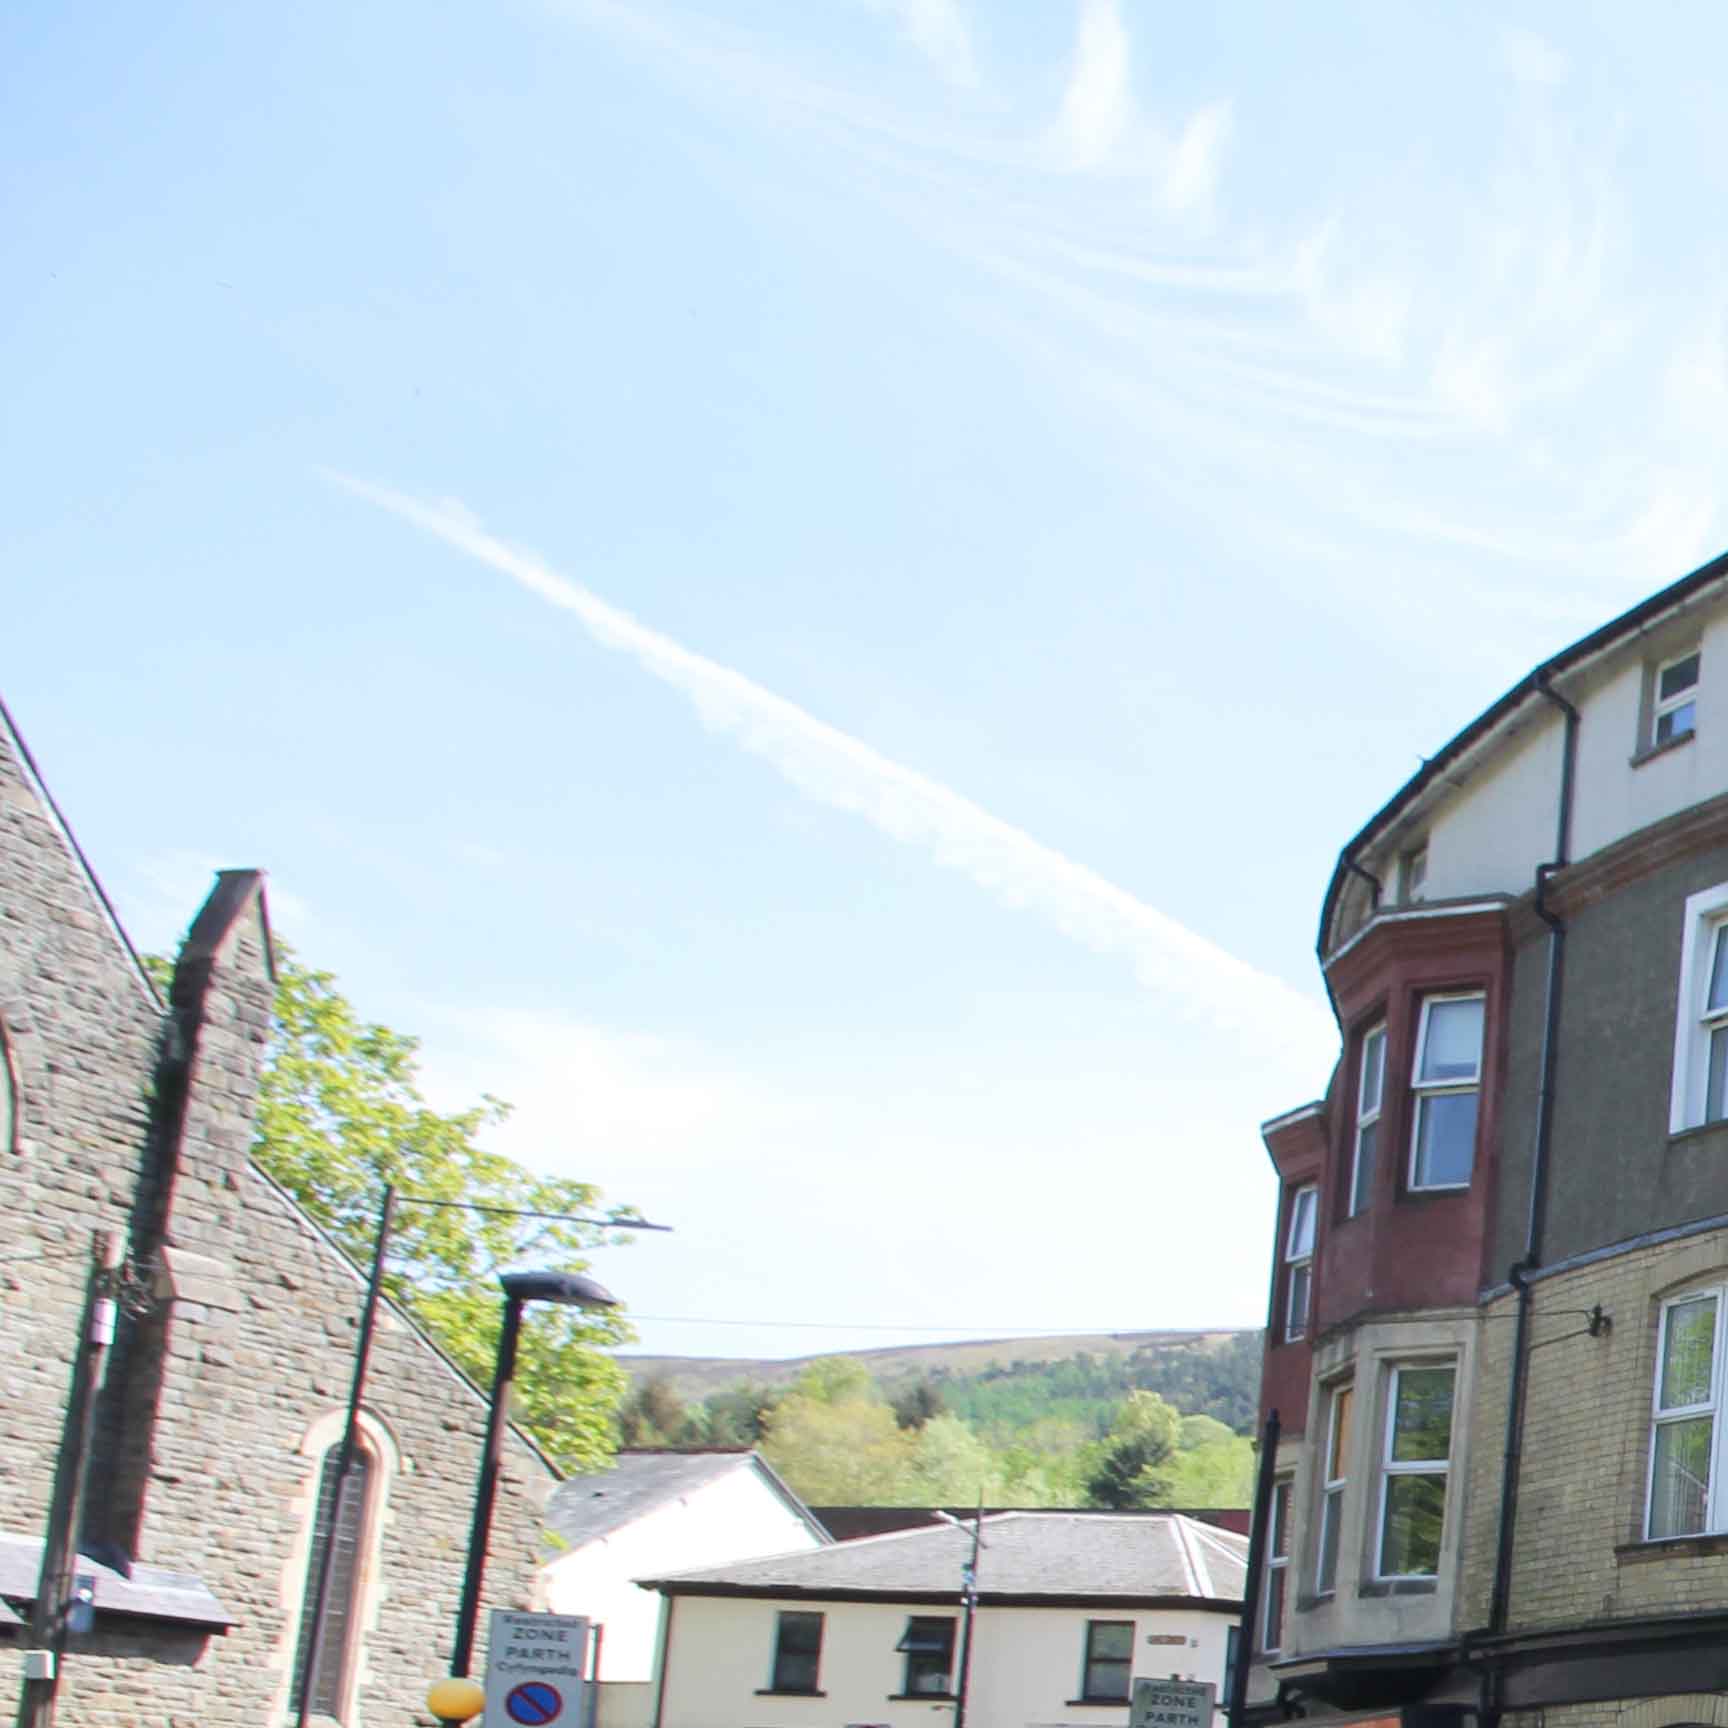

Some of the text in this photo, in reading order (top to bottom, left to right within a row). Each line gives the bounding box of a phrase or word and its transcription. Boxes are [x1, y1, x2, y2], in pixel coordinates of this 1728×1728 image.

[512, 1627, 569, 1642] ZONE
[505, 1647, 571, 1660] PARTH
[1151, 1695, 1197, 1708] ZONE
[1145, 1711, 1200, 1726] PARTH
